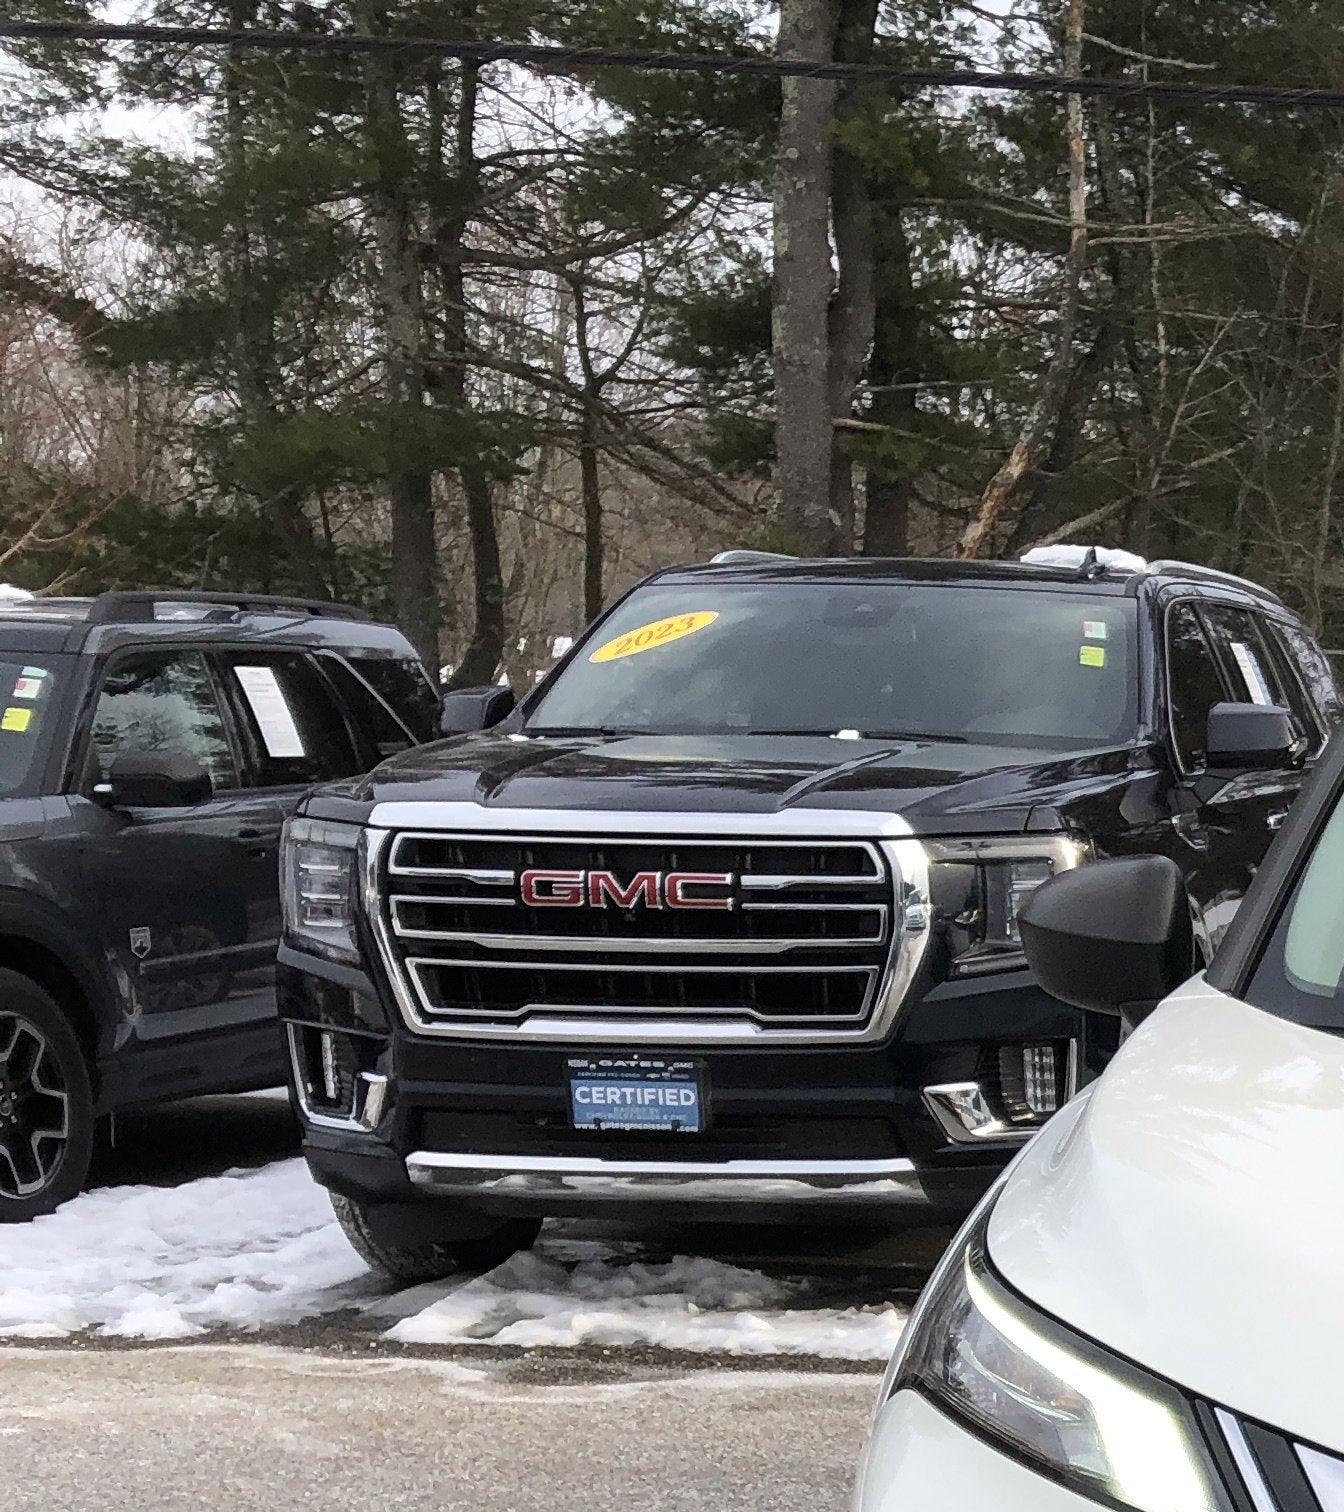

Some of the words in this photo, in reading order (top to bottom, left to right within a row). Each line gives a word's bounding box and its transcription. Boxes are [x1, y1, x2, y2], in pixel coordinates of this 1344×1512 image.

[614, 617, 695, 656] 2023
[520, 869, 734, 911] GMC
[575, 1086, 696, 1106] CERTIFIED
